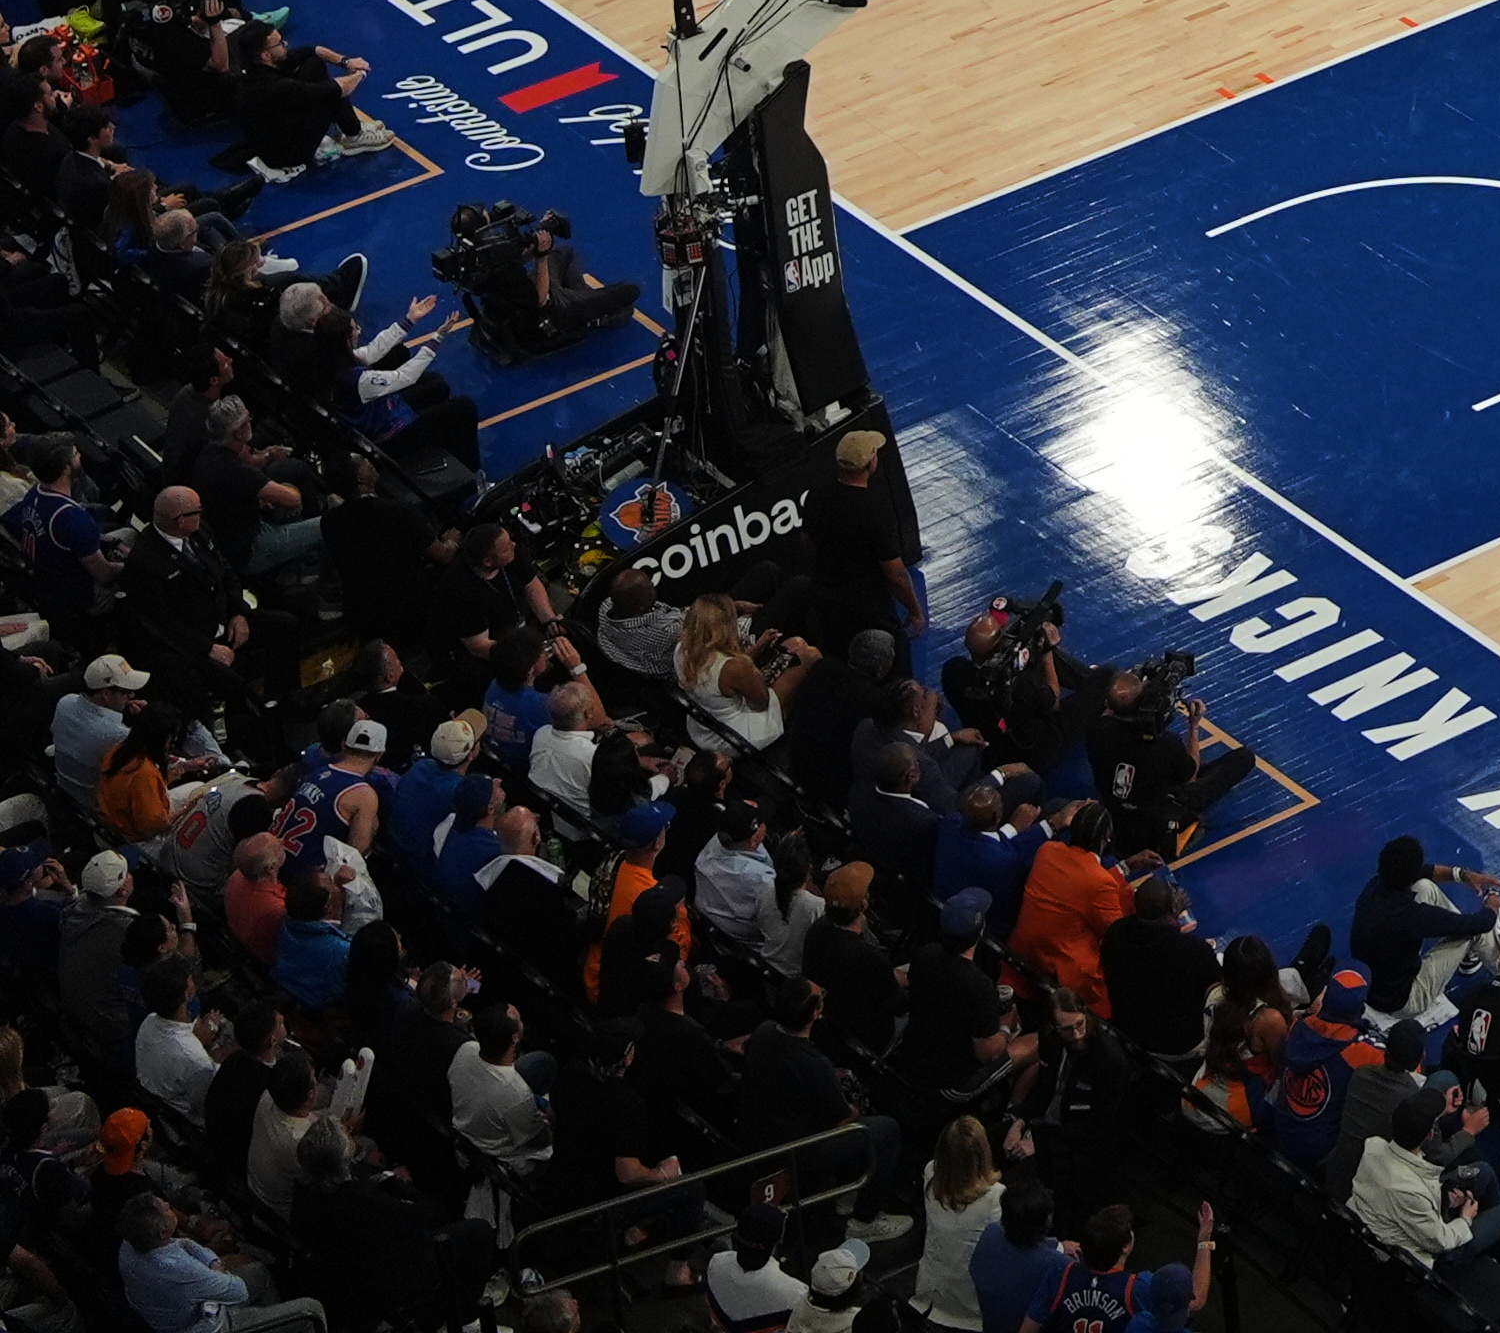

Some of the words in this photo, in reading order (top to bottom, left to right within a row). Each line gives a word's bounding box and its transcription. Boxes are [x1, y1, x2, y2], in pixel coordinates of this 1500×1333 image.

[384, 74, 544, 174] Courtside
[784, 189, 818, 229] GET
[787, 224, 824, 261] THE
[801, 251, 835, 290] App
[632, 485, 811, 589] coinba
[1126, 527, 1498, 762] KNICKS
[1063, 1285, 1126, 1323] BRUNSON
